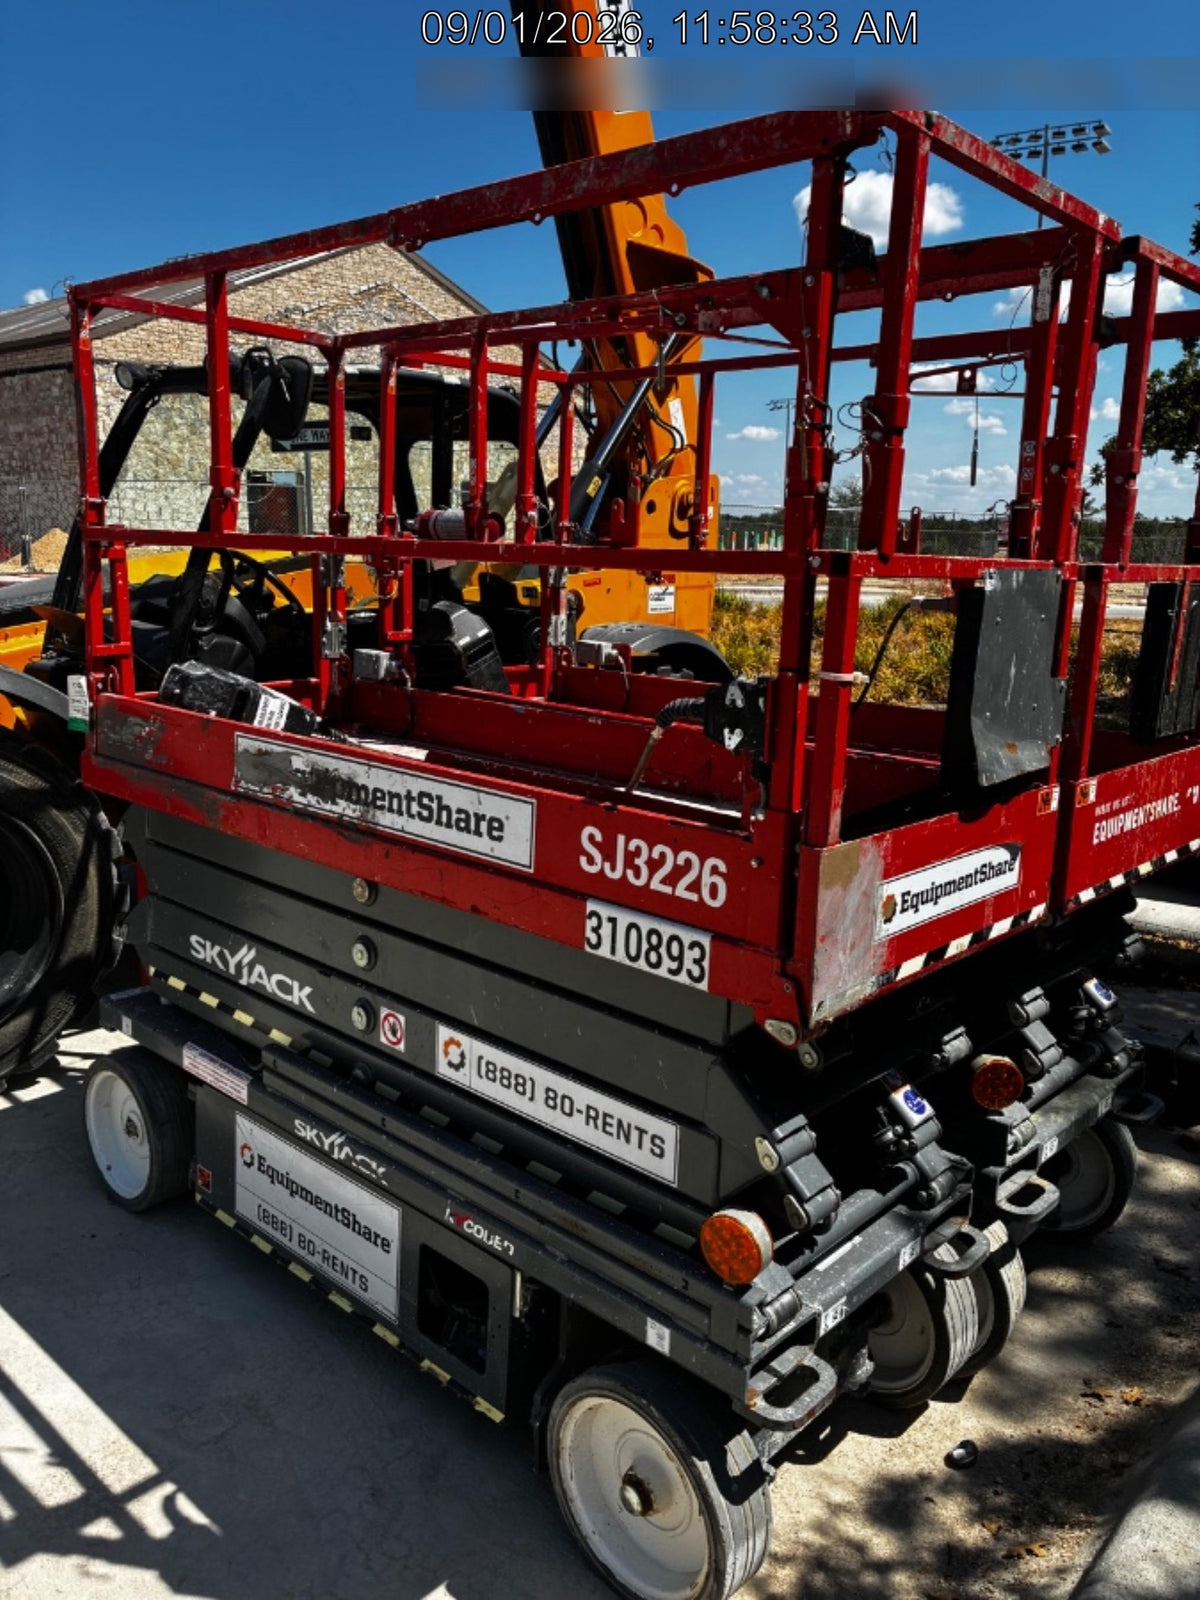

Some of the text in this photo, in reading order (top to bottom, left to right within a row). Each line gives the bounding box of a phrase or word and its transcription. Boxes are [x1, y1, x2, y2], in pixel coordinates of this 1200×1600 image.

[579, 825, 728, 908] SJ3226
[900, 857, 1017, 915] EquipmentShare
[189, 934, 317, 1015] SKYJACK
[585, 910, 707, 984] 310893
[476, 1055, 666, 1160] (888) 80-RENTS
[257, 1153, 392, 1254] EquipmentShare
[257, 1203, 369, 1293] (888) 80-RENTS
